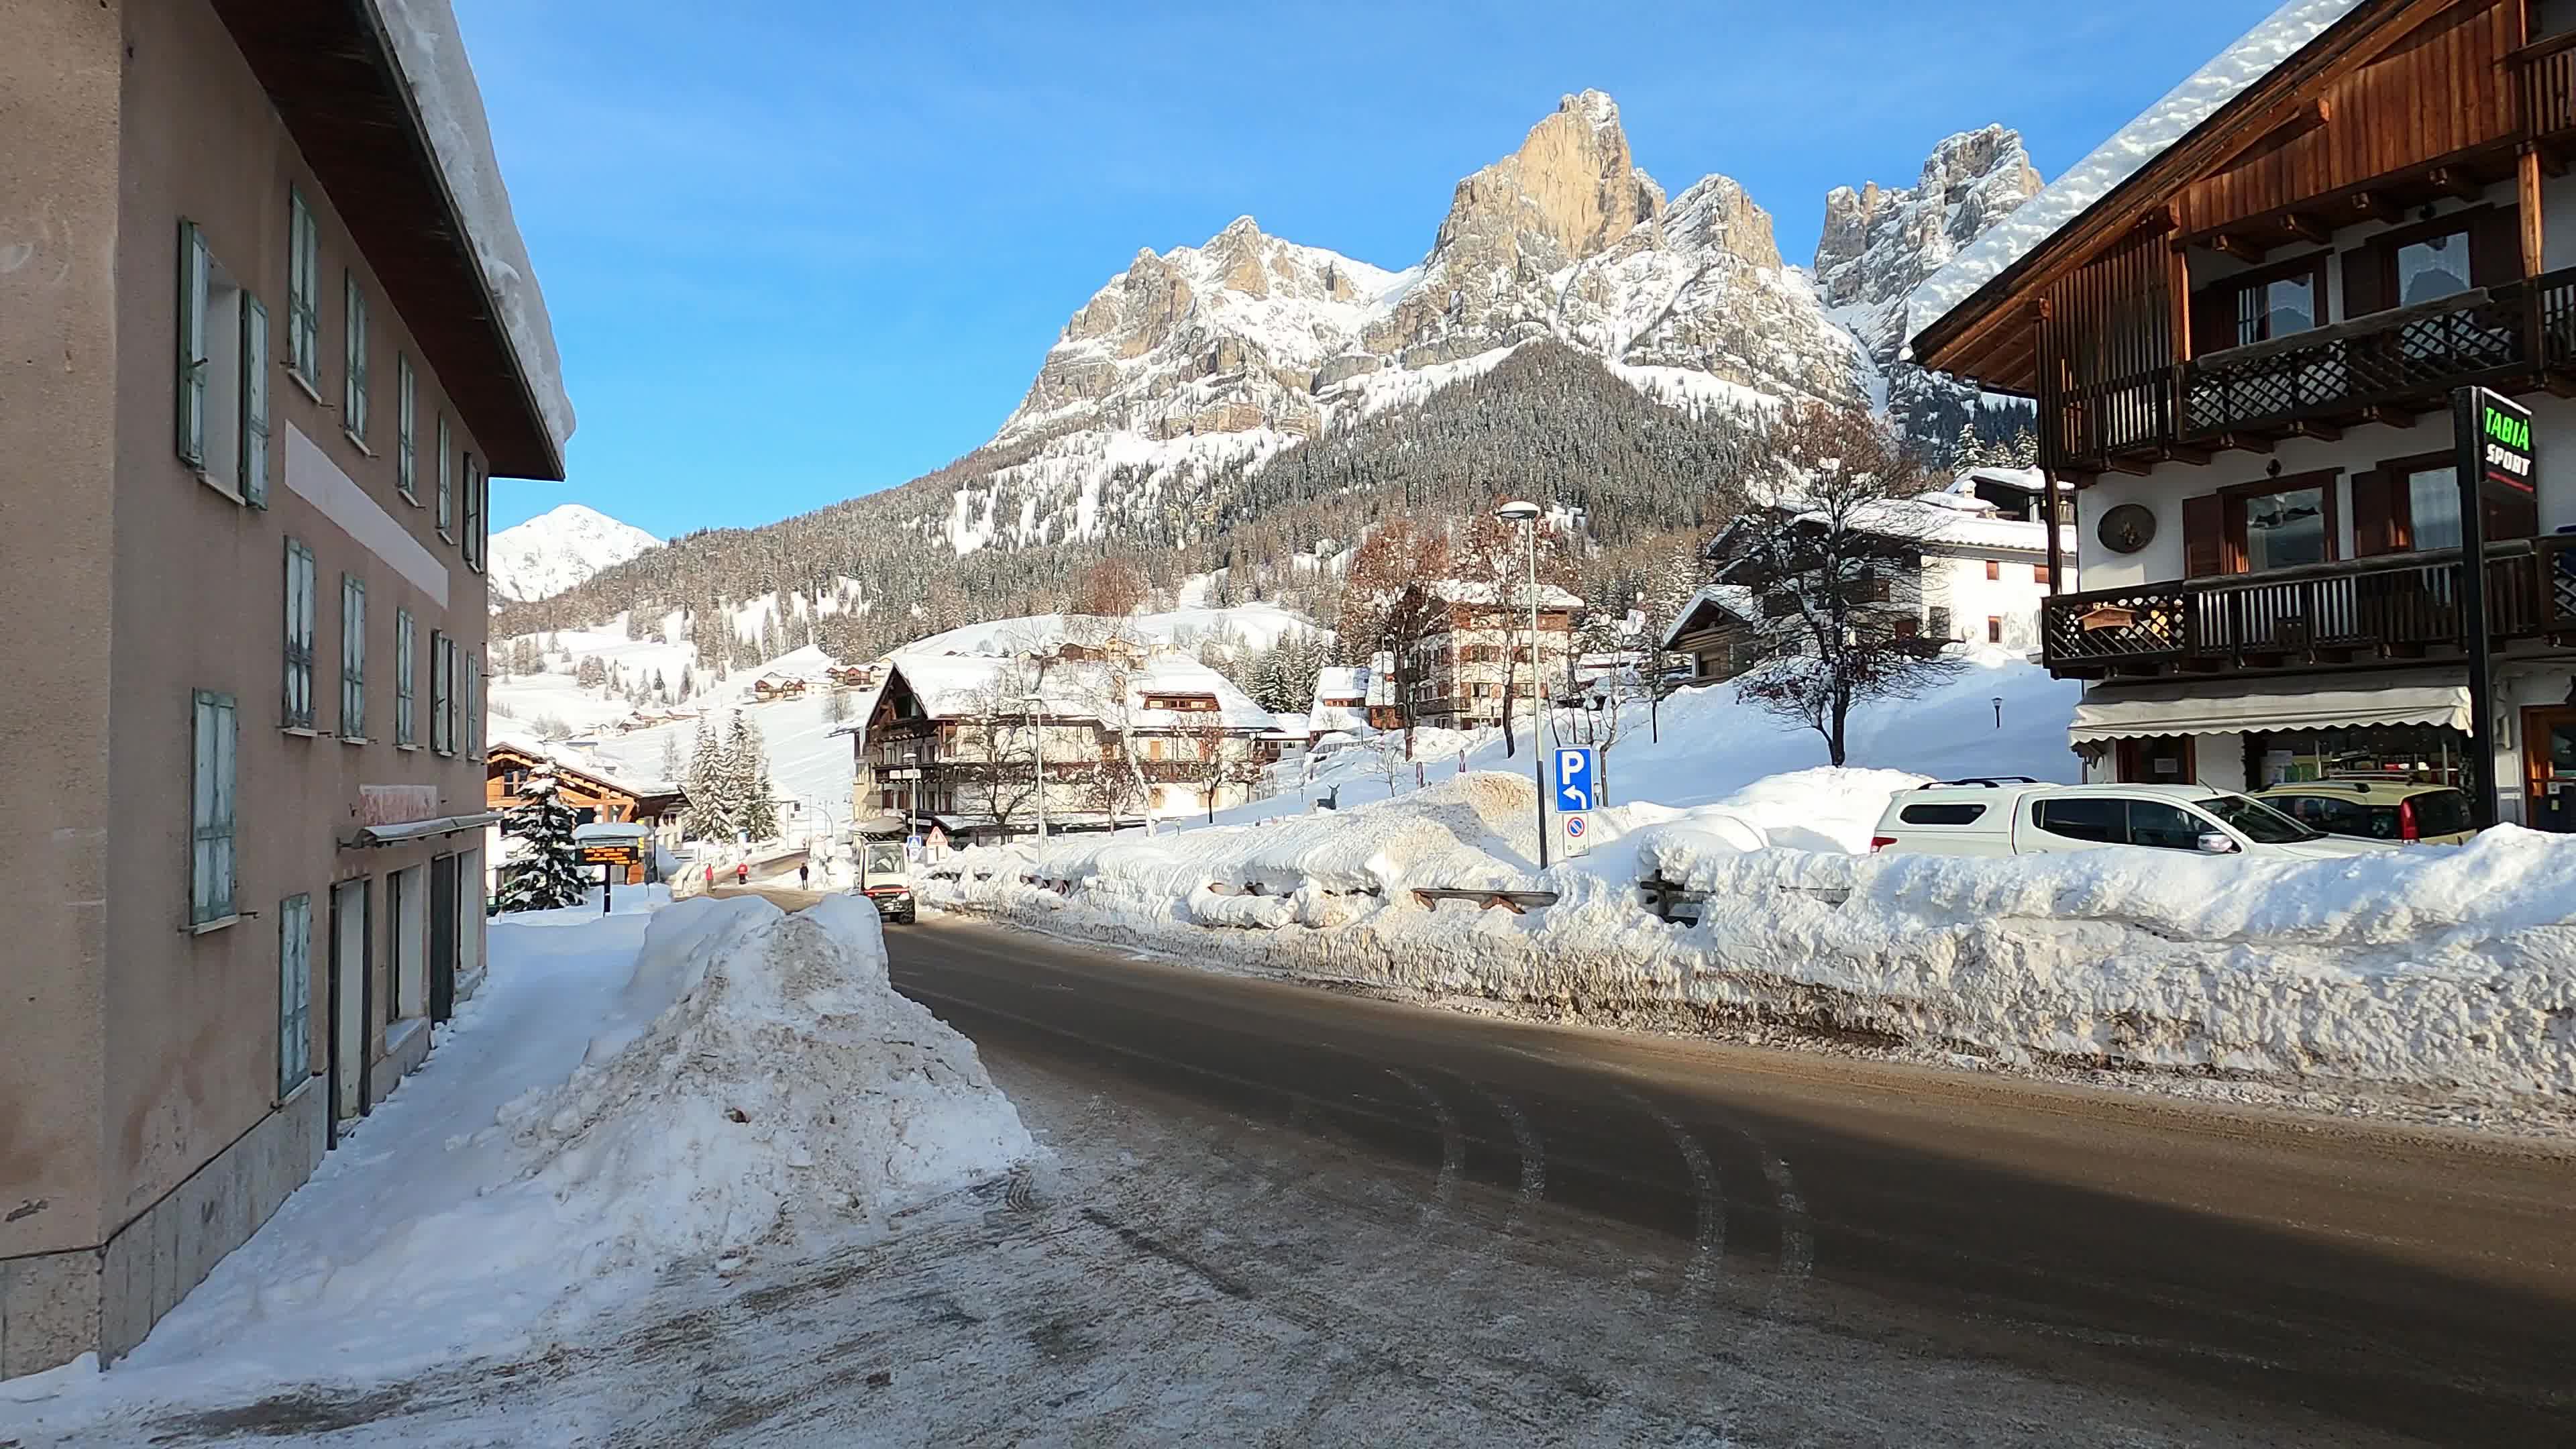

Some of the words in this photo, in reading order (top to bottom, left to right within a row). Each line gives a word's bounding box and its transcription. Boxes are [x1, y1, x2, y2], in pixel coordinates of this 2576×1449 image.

[2485, 407, 2529, 451] TABIÀ
[2485, 443, 2530, 476] SPORT
[1562, 751, 1585, 785] P
